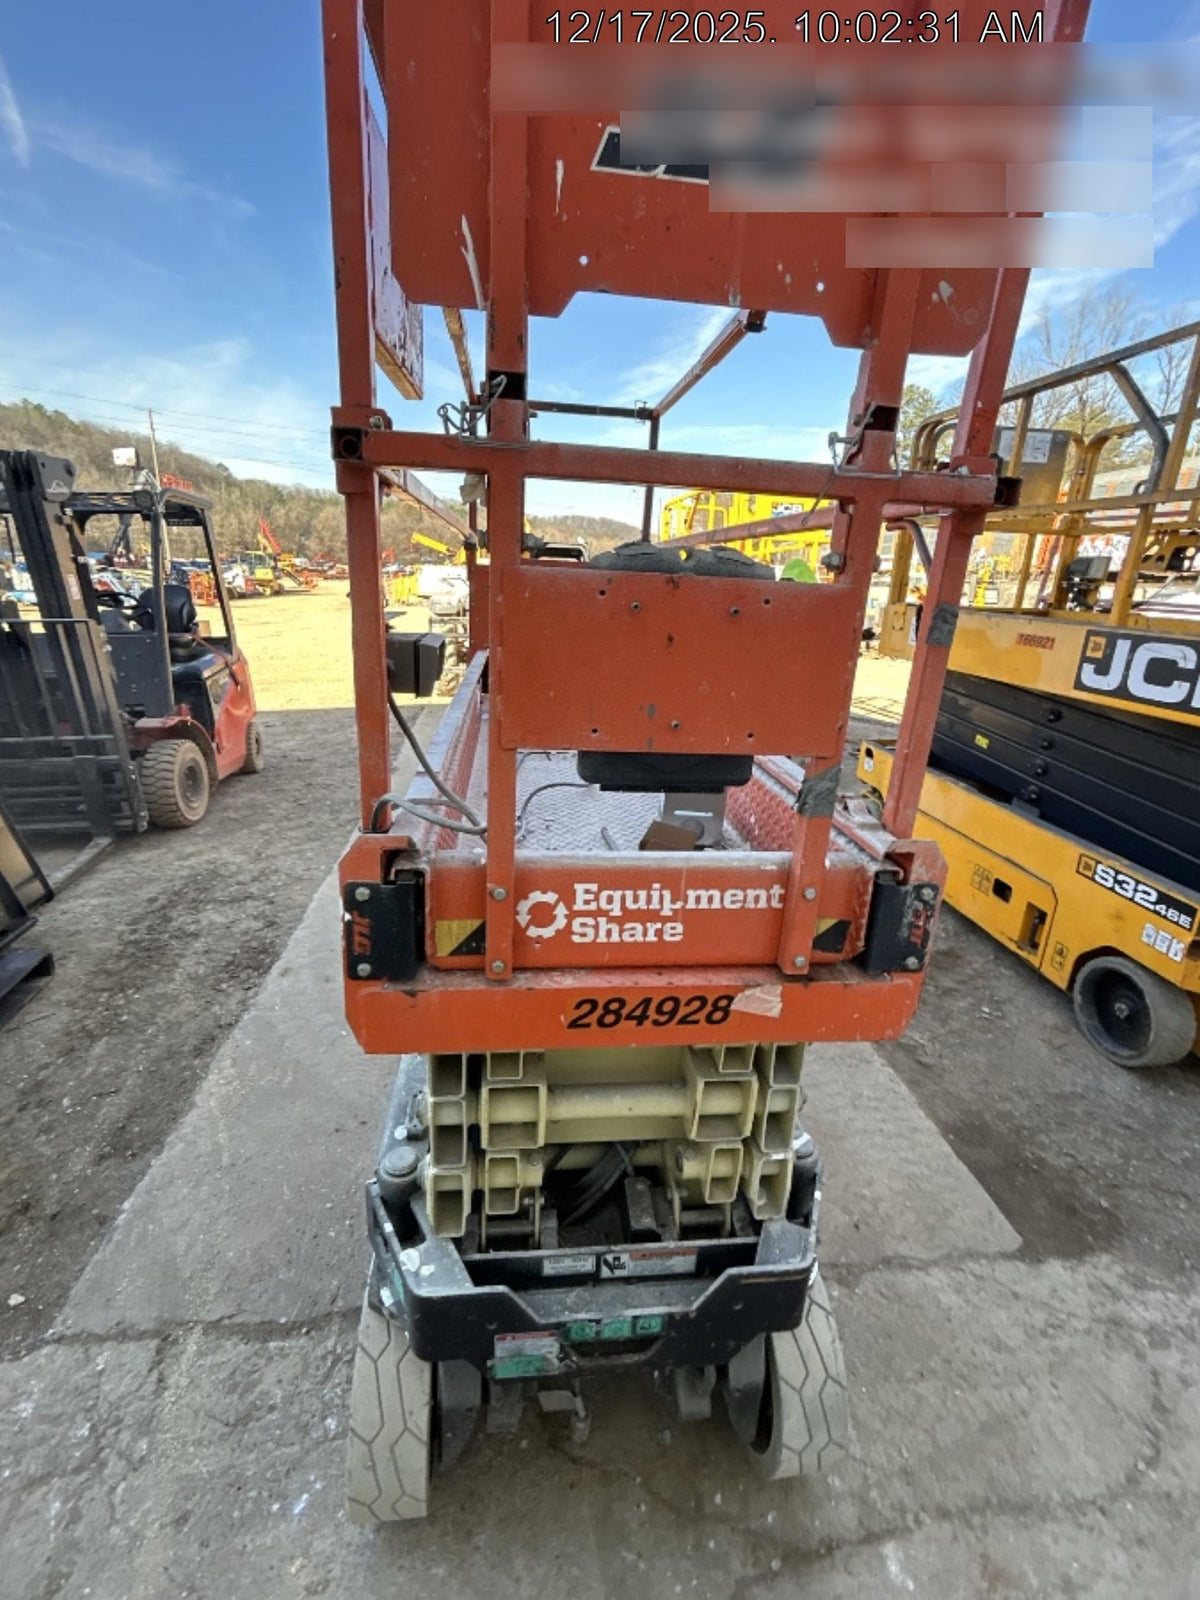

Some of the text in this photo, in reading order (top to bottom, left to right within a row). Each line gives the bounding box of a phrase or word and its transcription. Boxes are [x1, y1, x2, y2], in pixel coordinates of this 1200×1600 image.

[1081, 638, 1200, 708] JC
[571, 916, 683, 943] Share
[567, 994, 735, 1030] 284928
